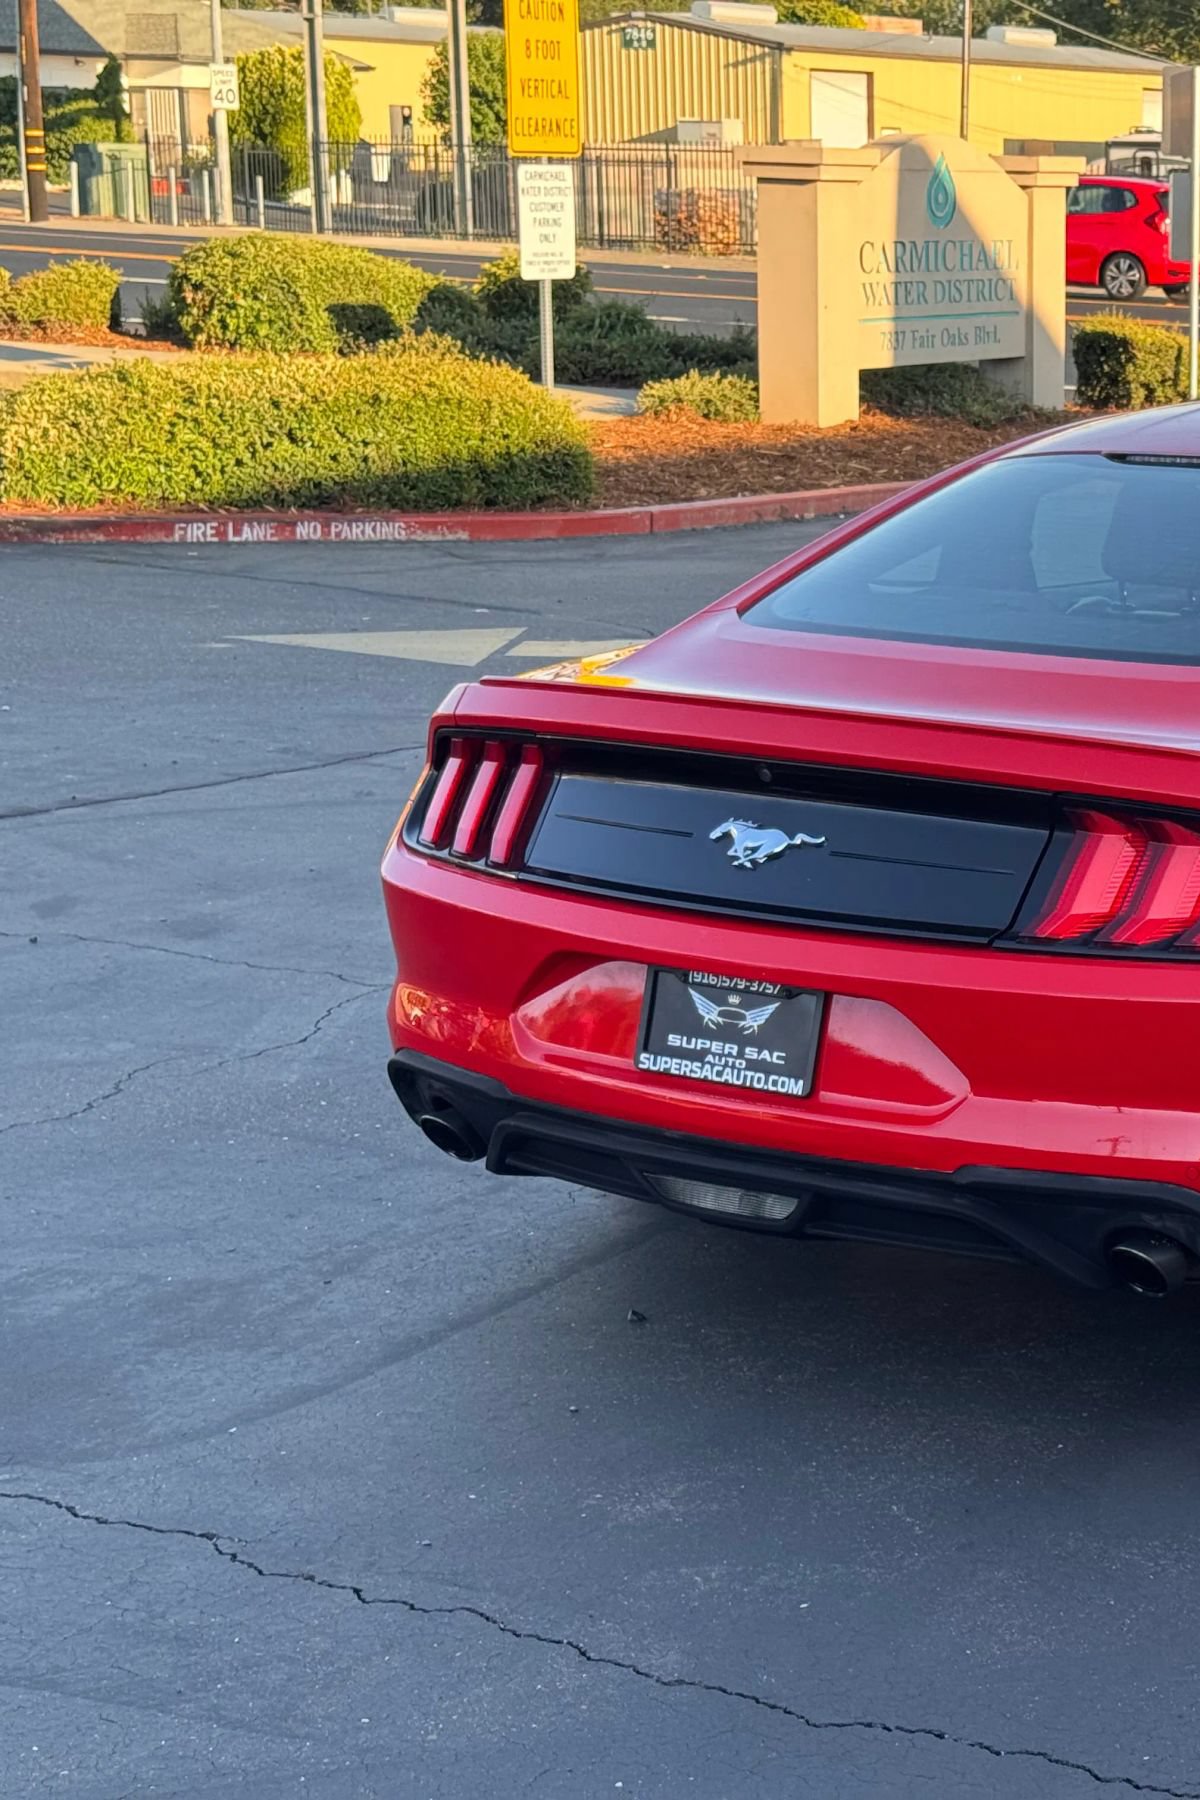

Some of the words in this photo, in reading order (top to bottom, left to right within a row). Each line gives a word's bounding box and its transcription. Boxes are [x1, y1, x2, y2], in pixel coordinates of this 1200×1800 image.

[519, 0, 565, 21] CAUTION
[625, 28, 654, 41] 7846
[525, 38, 532, 60] 8
[535, 39, 561, 61] FOOT
[214, 88, 236, 104] 40
[520, 78, 570, 100] VERTICAL
[514, 117, 576, 138] CLEARANCE
[524, 170, 567, 181] CARMICHAEL
[521, 186, 541, 197] WATER
[543, 186, 572, 197] DISTRICT
[529, 202, 564, 212] CUSTOMER
[533, 217, 562, 228] PARKING
[539, 233, 556, 244] ONLY
[859, 239, 1019, 274] CARMICHAEL
[861, 280, 929, 307] WATER
[933, 277, 1017, 304] DISTRICT
[911, 328, 936, 349] Fair
[940, 327, 969, 348] Oaks
[174, 522, 219, 542] FIRE
[228, 522, 279, 542] LANE
[296, 521, 322, 540] NO
[330, 521, 407, 541] PARKING
[688, 970, 781, 994] (916)579-3757
[667, 1033, 739, 1057] SUPER
[744, 1046, 786, 1065] SAC
[704, 1054, 747, 1069] AUTO
[637, 1052, 804, 1096] SUPERSACAUTO.COM
